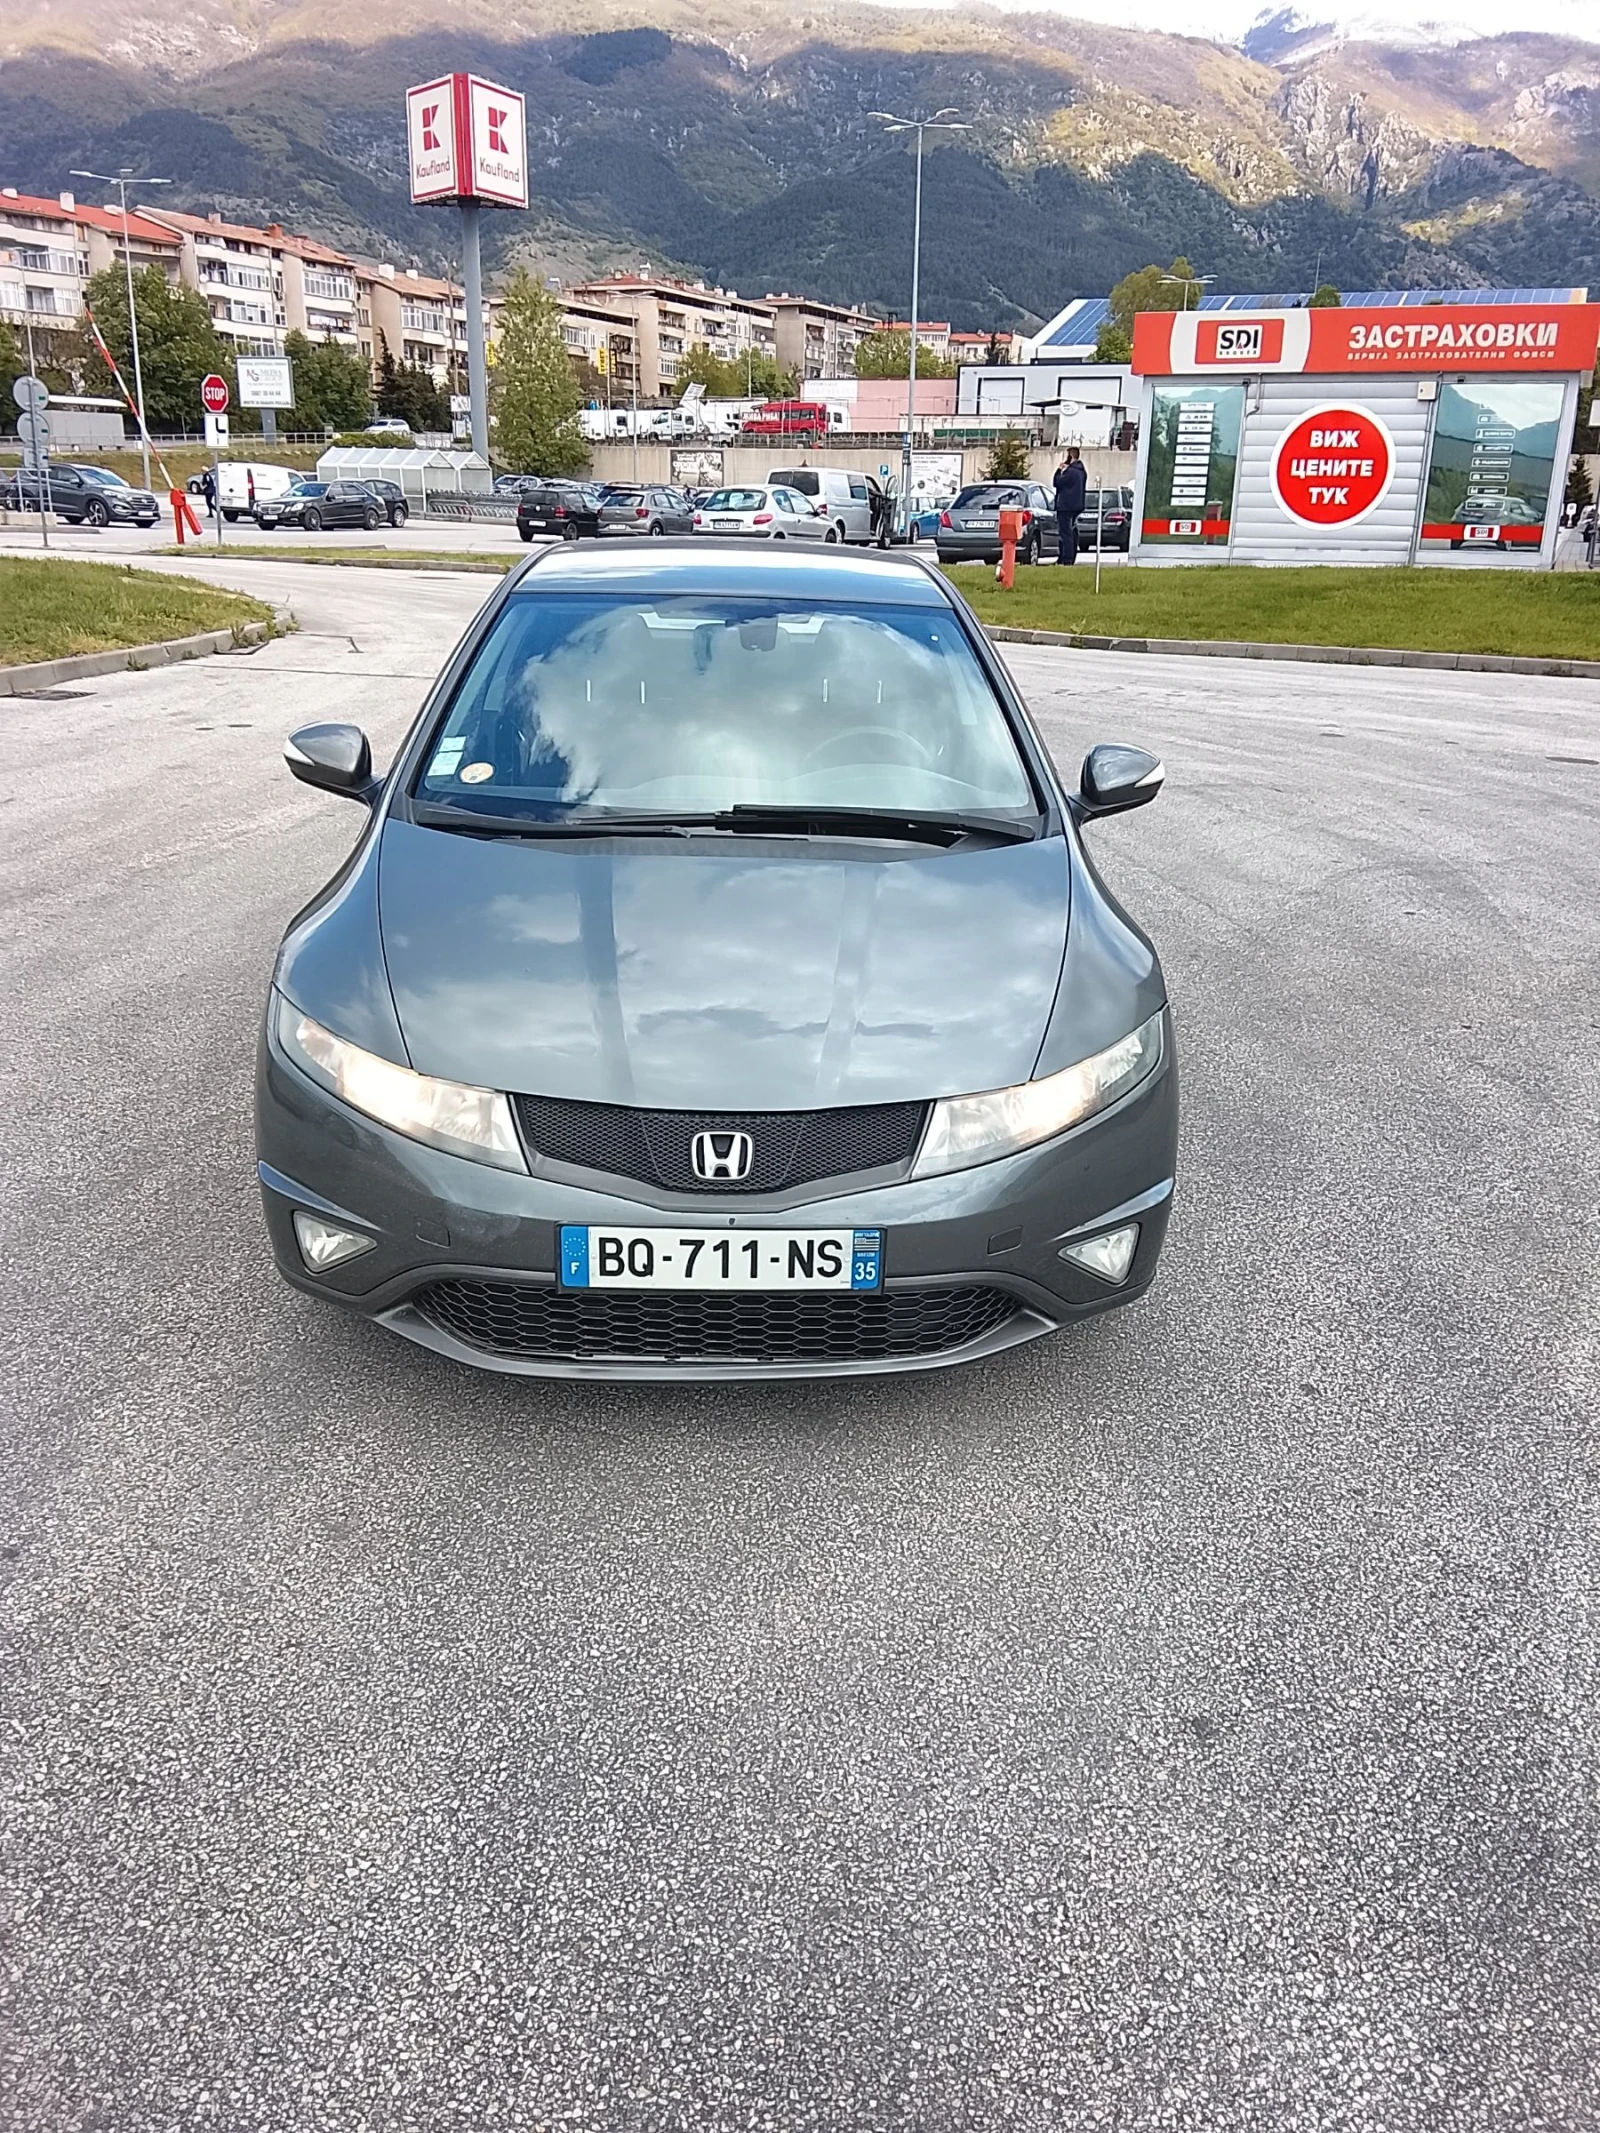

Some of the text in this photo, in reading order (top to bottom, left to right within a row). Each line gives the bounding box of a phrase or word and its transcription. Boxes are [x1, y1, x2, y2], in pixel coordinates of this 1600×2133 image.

[416, 156, 451, 179] Kaufland
[480, 157, 520, 182] Kaufland
[1219, 329, 1259, 350] SDI
[1348, 323, 1559, 349] ЗАСТРАХОВКИ
[1347, 350, 1555, 360] ВЕРИГА ЗАСТРАХОВАТЕЛНИ ОФИСИ
[205, 387, 225, 401] STOP
[742, 411, 761, 421] ЖИВА
[1310, 430, 1360, 448] ВИЖ
[1290, 459, 1374, 479] ЦЕНИТЕ
[1308, 487, 1350, 505] ТУК
[598, 1237, 843, 1279] BQ-711-NS
[571, 1262, 580, 1275] F
[854, 1262, 876, 1280] 35
